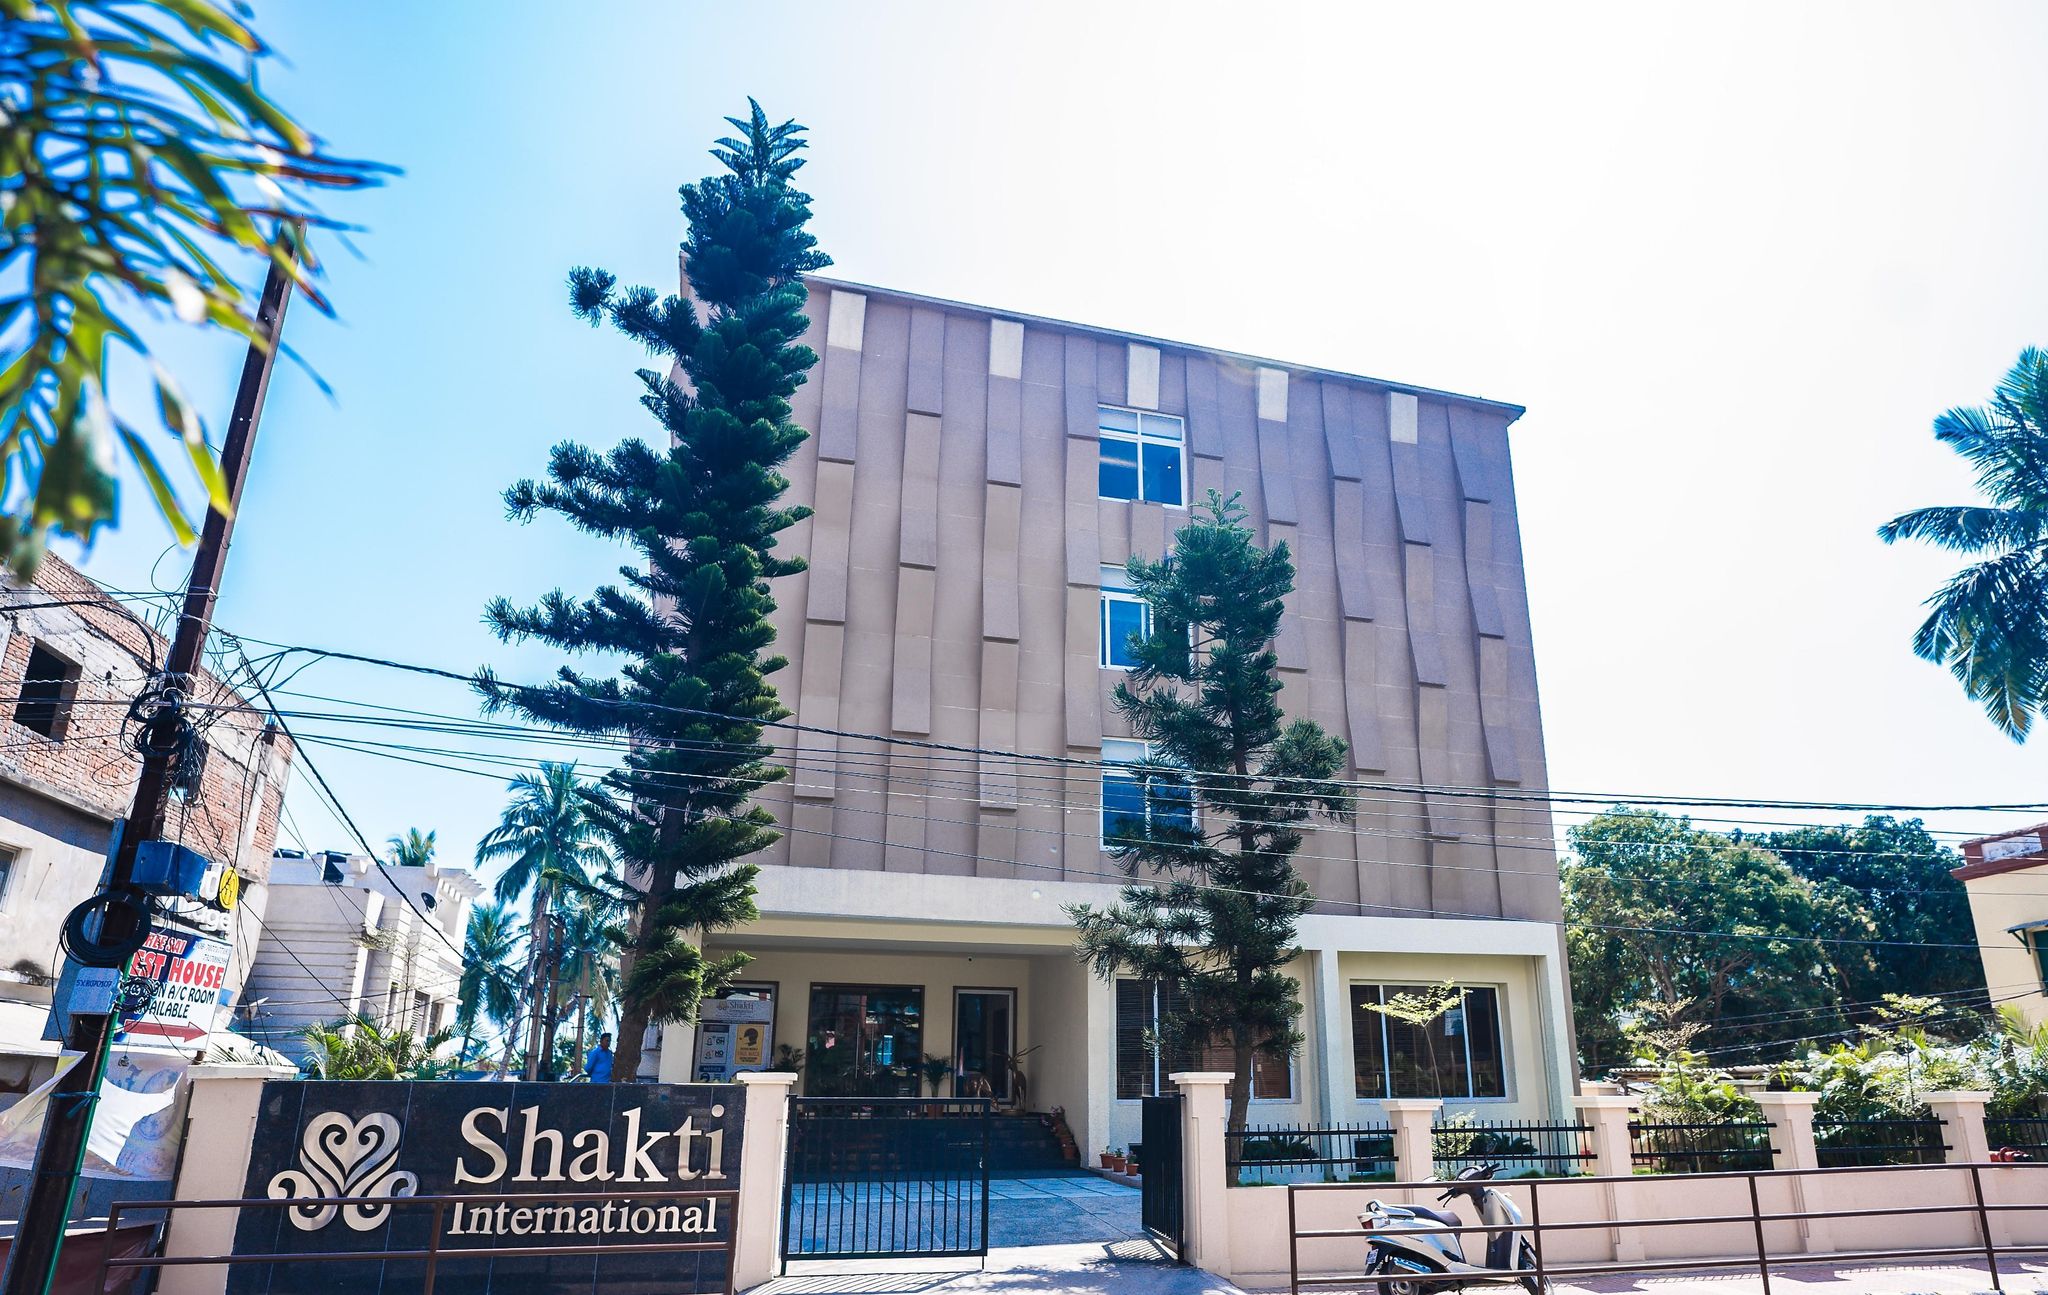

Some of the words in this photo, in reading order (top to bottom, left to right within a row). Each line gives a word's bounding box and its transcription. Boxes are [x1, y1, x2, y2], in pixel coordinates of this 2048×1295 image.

[129, 949, 167, 979] EST
[167, 957, 225, 989] HOUSE
[149, 1000, 190, 1019] AILABLE
[167, 985, 187, 1001] A/C
[187, 986, 215, 1005] ROOM
[454, 1104, 727, 1185] Shakti
[446, 1197, 718, 1235] International
